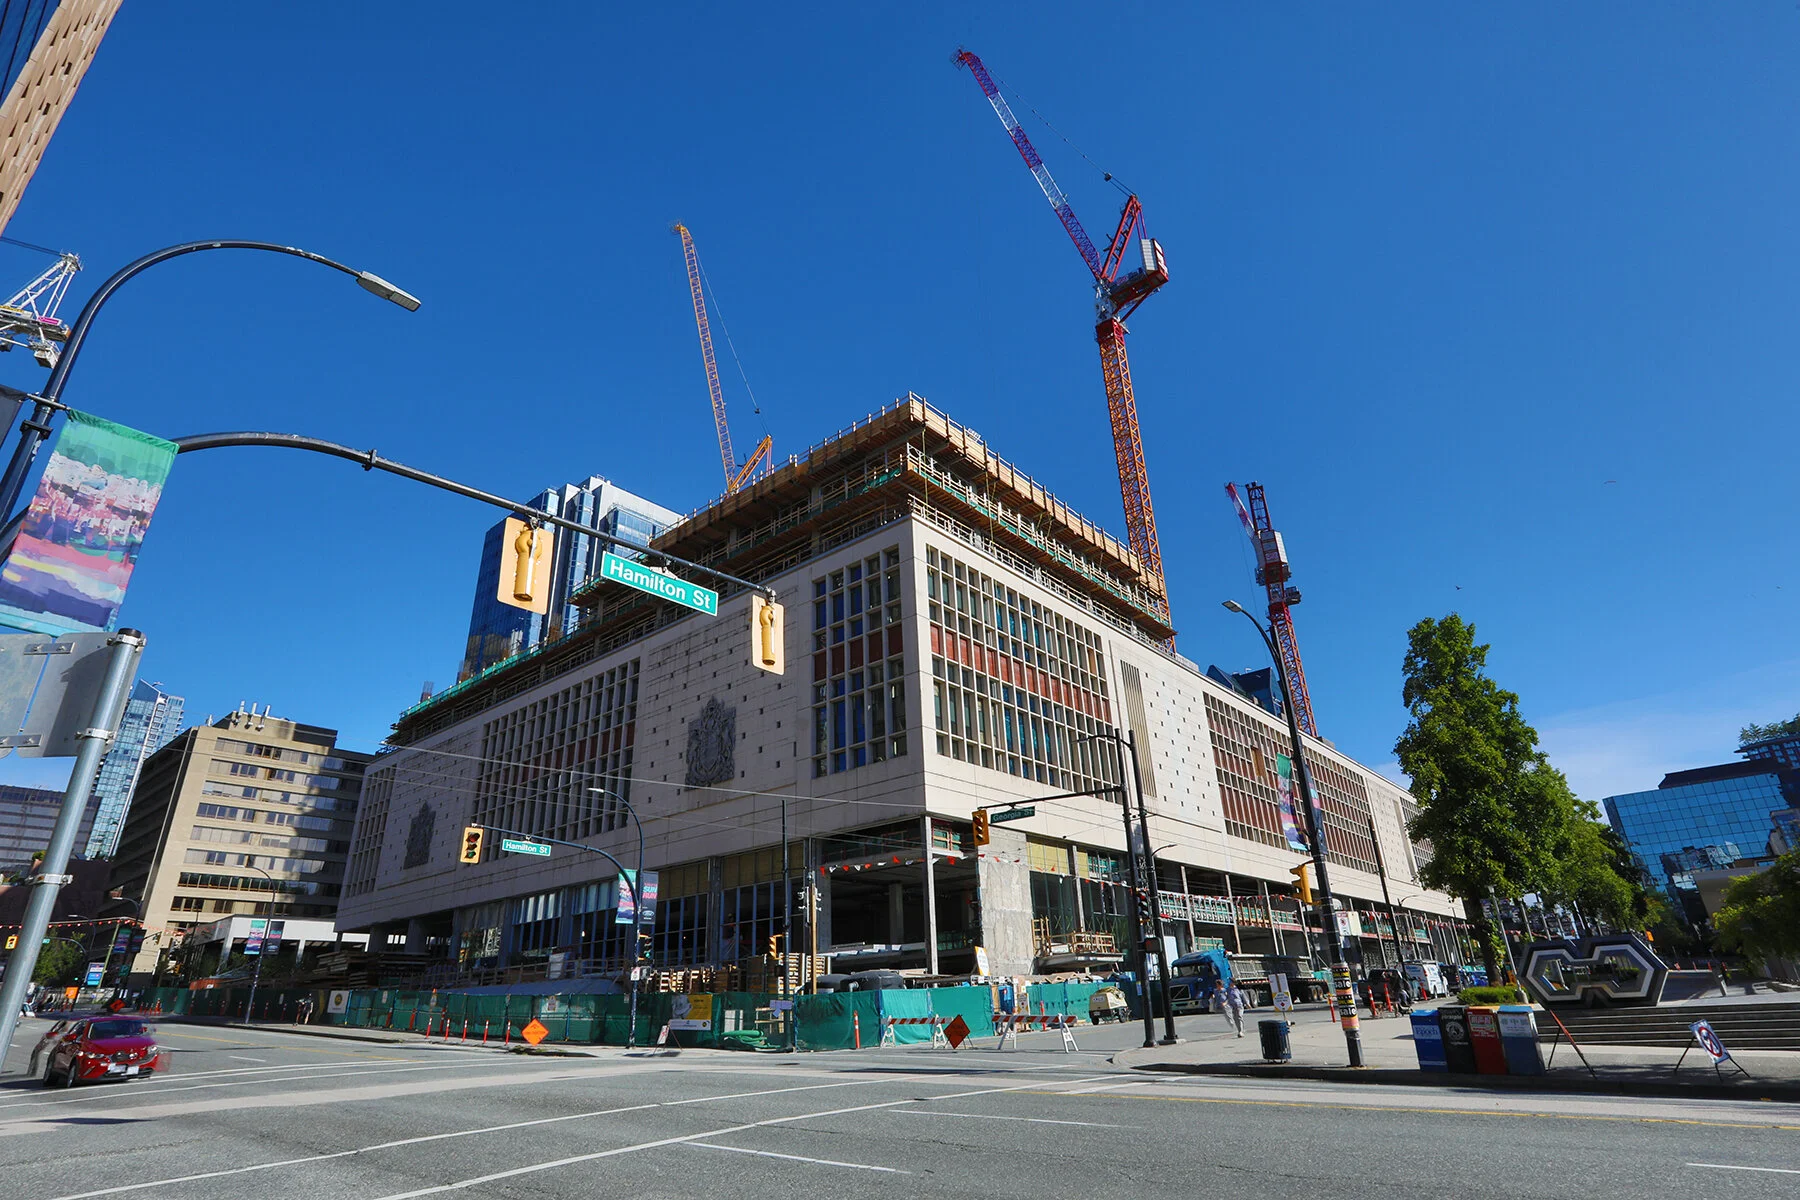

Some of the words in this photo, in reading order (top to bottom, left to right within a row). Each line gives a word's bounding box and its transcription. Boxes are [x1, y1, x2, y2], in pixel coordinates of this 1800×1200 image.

[610, 560, 686, 600] Hamilton
[692, 590, 711, 609] St
[993, 811, 1021, 821] Georgia
[1024, 808, 1034, 816] St
[505, 842, 537, 852] Hamilton
[539, 846, 548, 854] St
[1335, 980, 1351, 988] sale
[1340, 1007, 1357, 1016] sale
